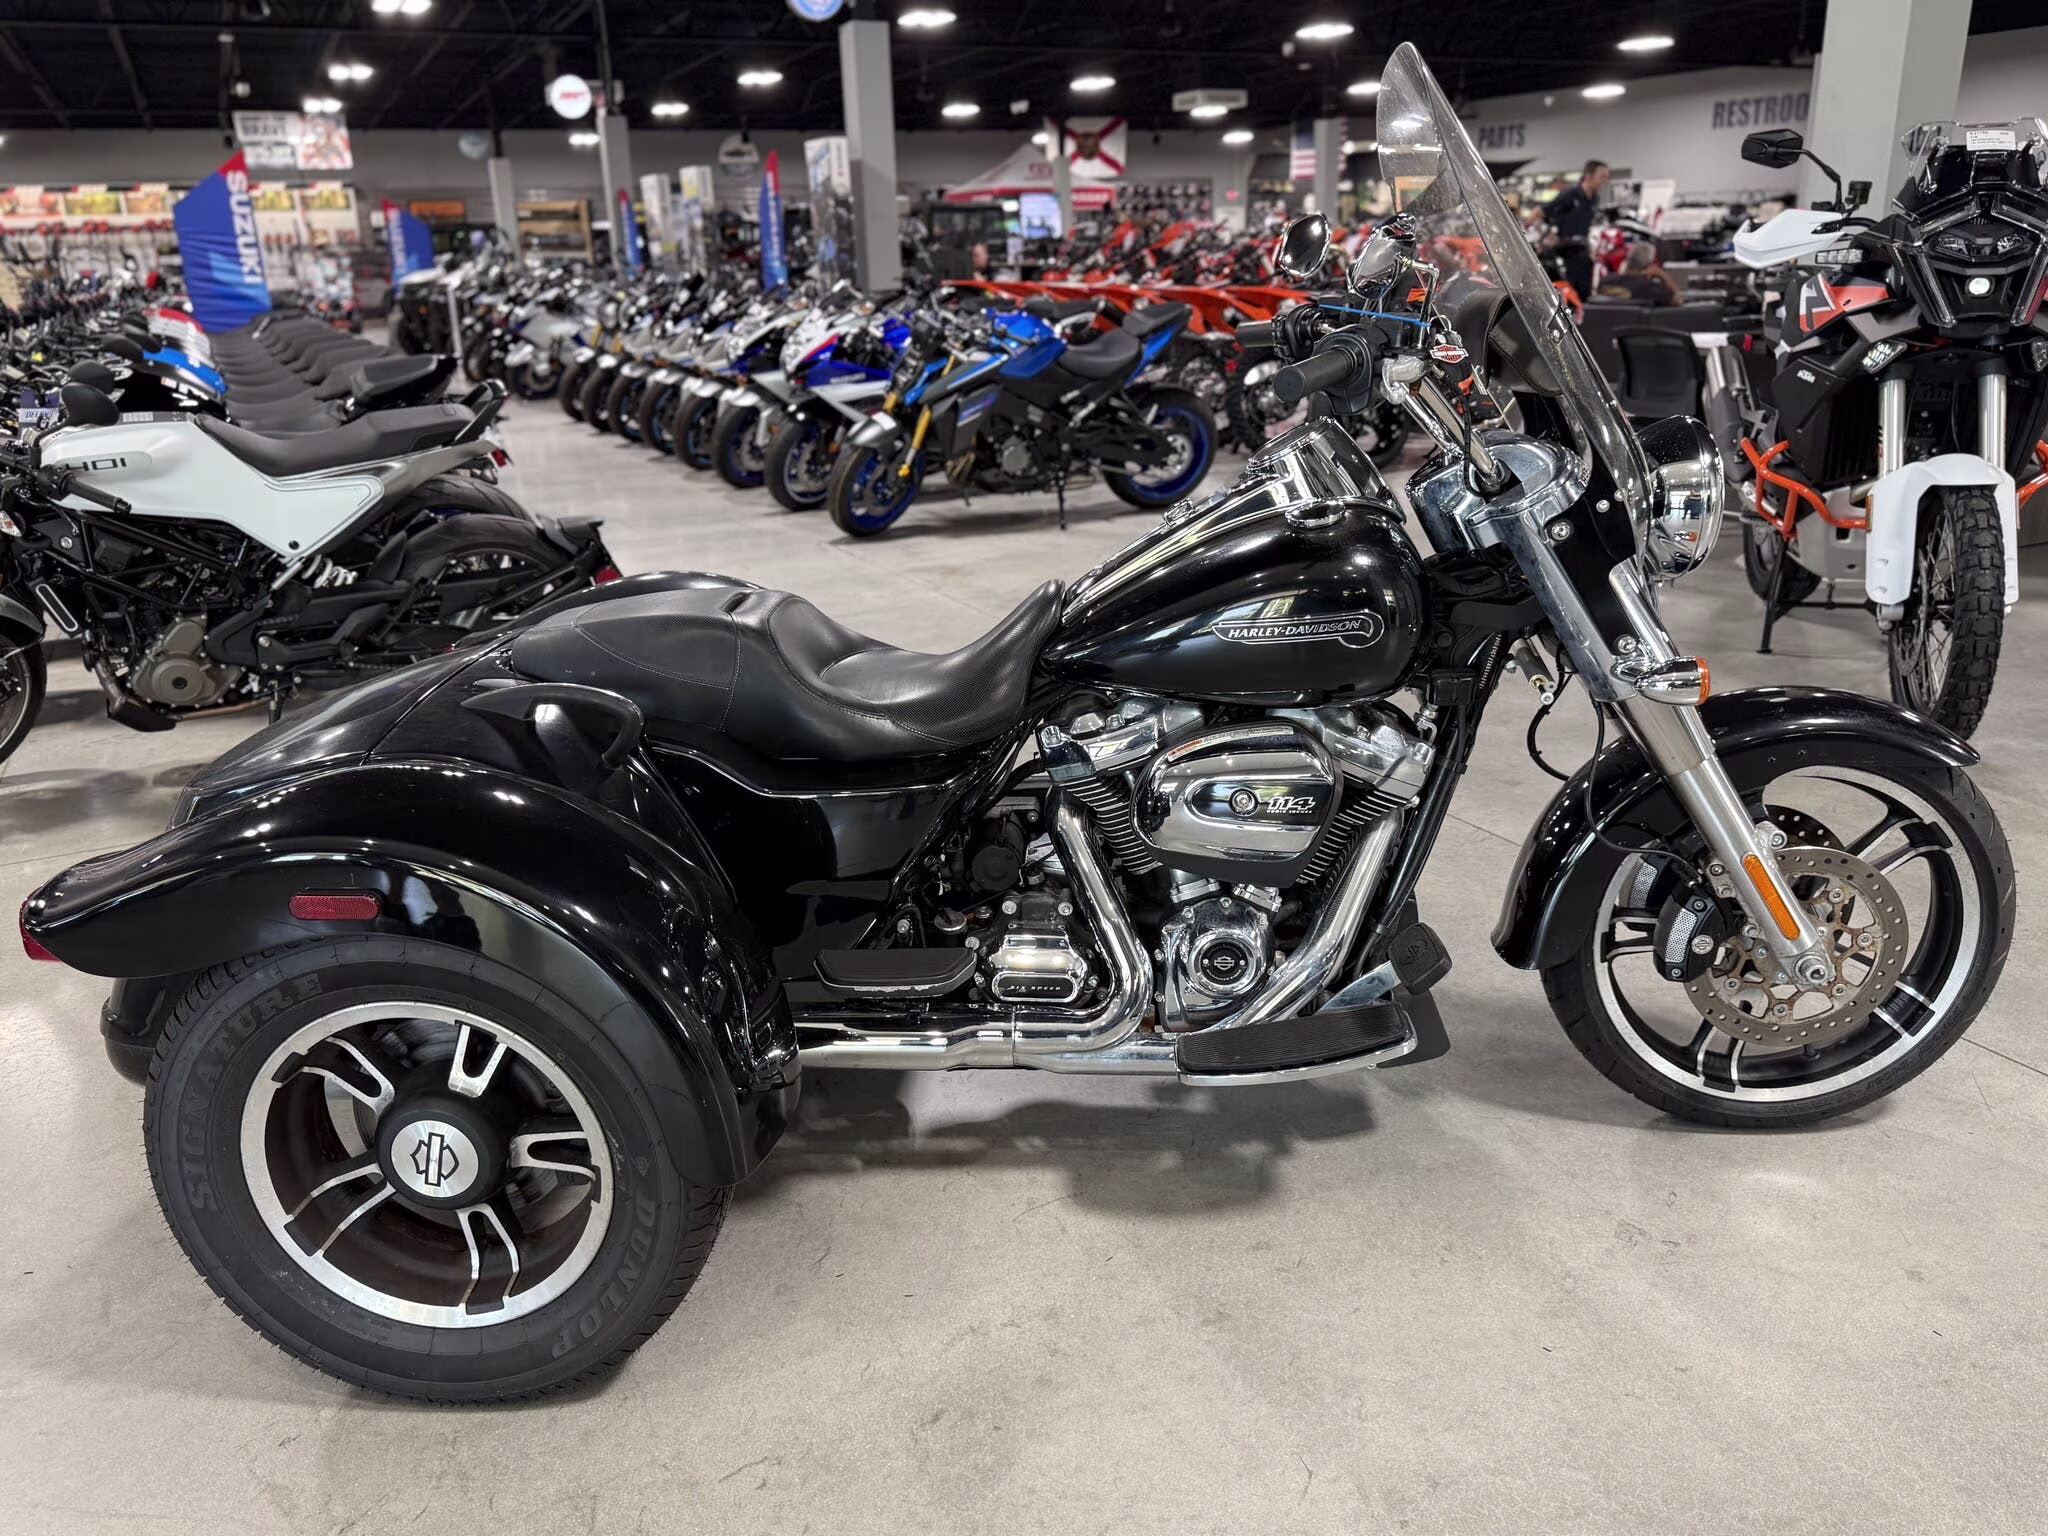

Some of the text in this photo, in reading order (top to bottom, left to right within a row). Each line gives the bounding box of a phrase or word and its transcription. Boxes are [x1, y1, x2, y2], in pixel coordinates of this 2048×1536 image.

[1479, 123, 1526, 150] PARTS
[226, 170, 264, 284] SUZUKI
[1228, 618, 1363, 639] HARLEY-DAVIDSON
[1267, 796, 1316, 810] 114
[180, 972, 323, 1210] SIGNATURE
[551, 1189, 656, 1359] DUNLOP
